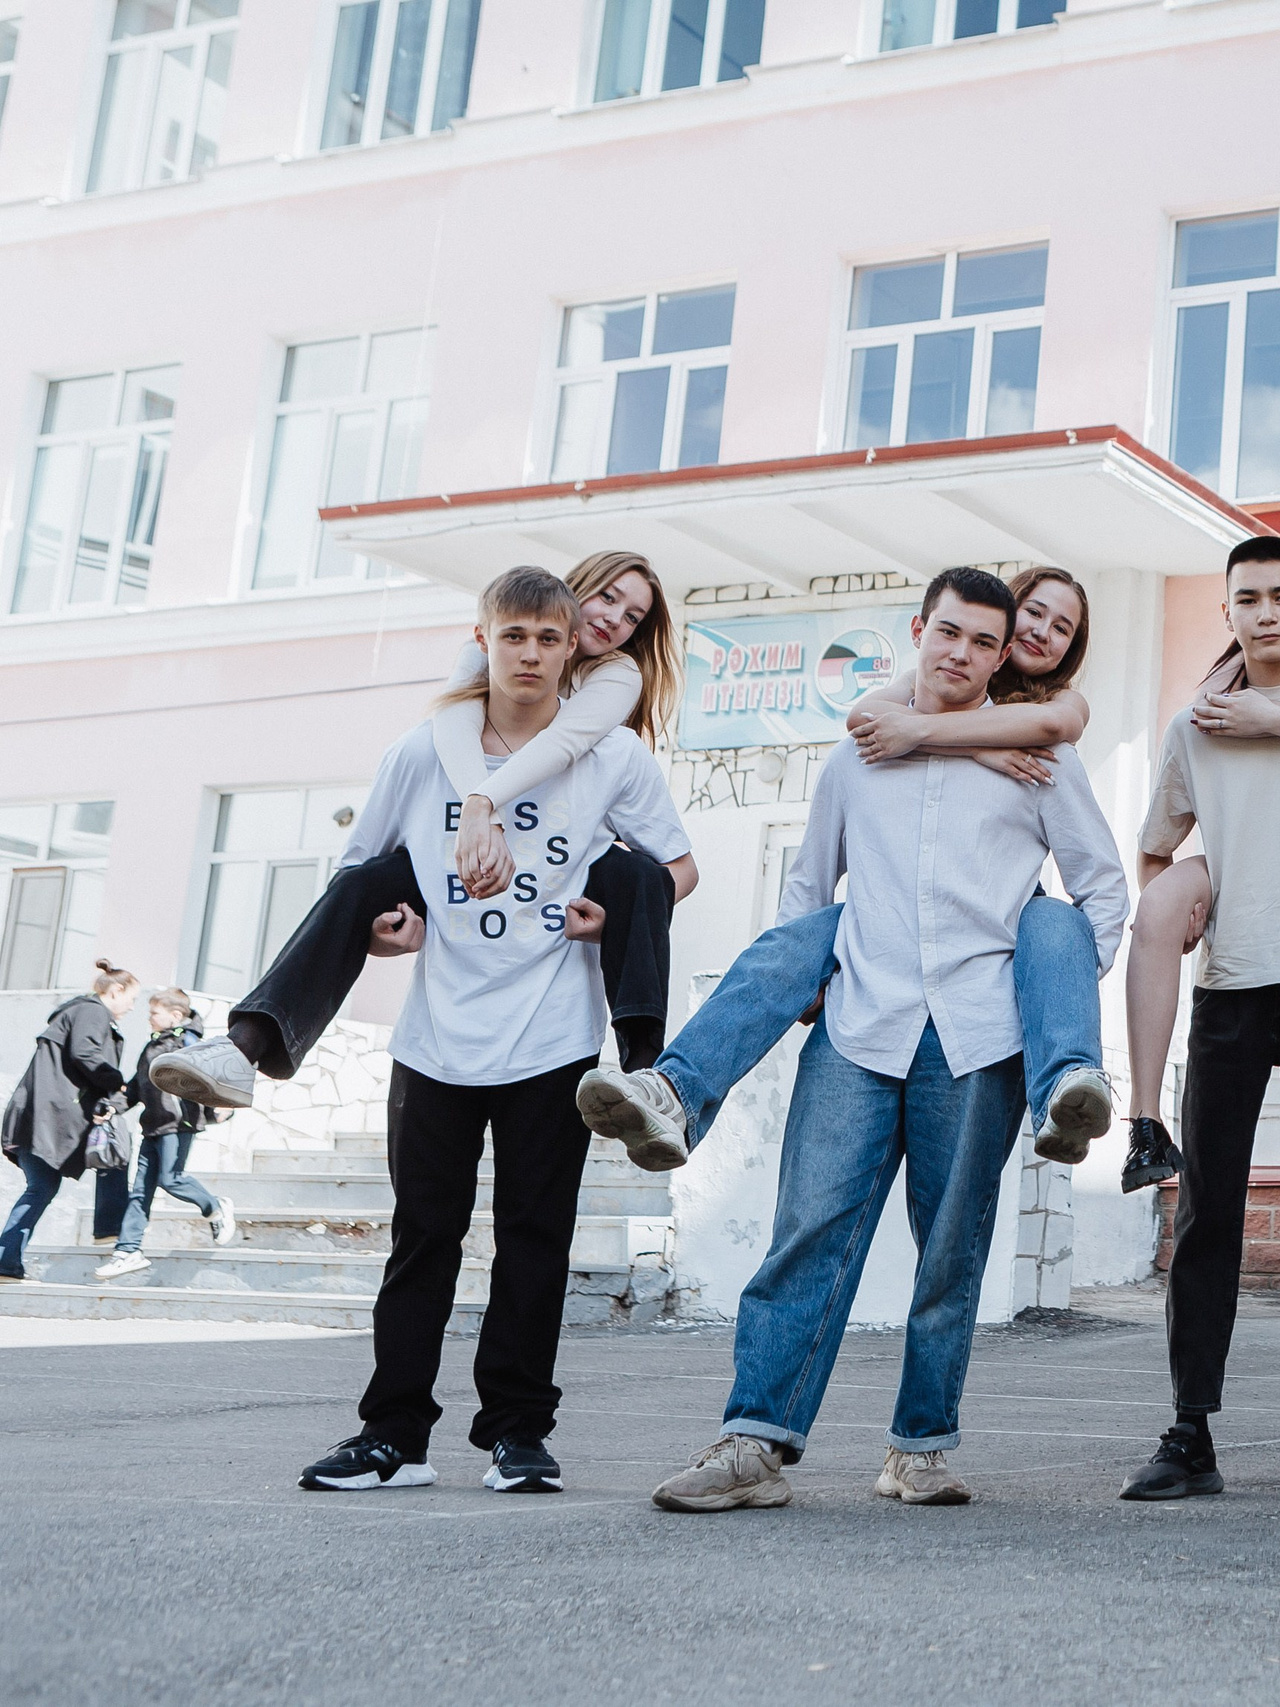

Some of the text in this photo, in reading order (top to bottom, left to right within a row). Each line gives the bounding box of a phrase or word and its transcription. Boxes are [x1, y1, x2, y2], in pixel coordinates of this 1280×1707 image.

[711, 642, 802, 676] РӘХИМ
[872, 657, 891, 670] 86
[445, 800, 569, 832] BSS
